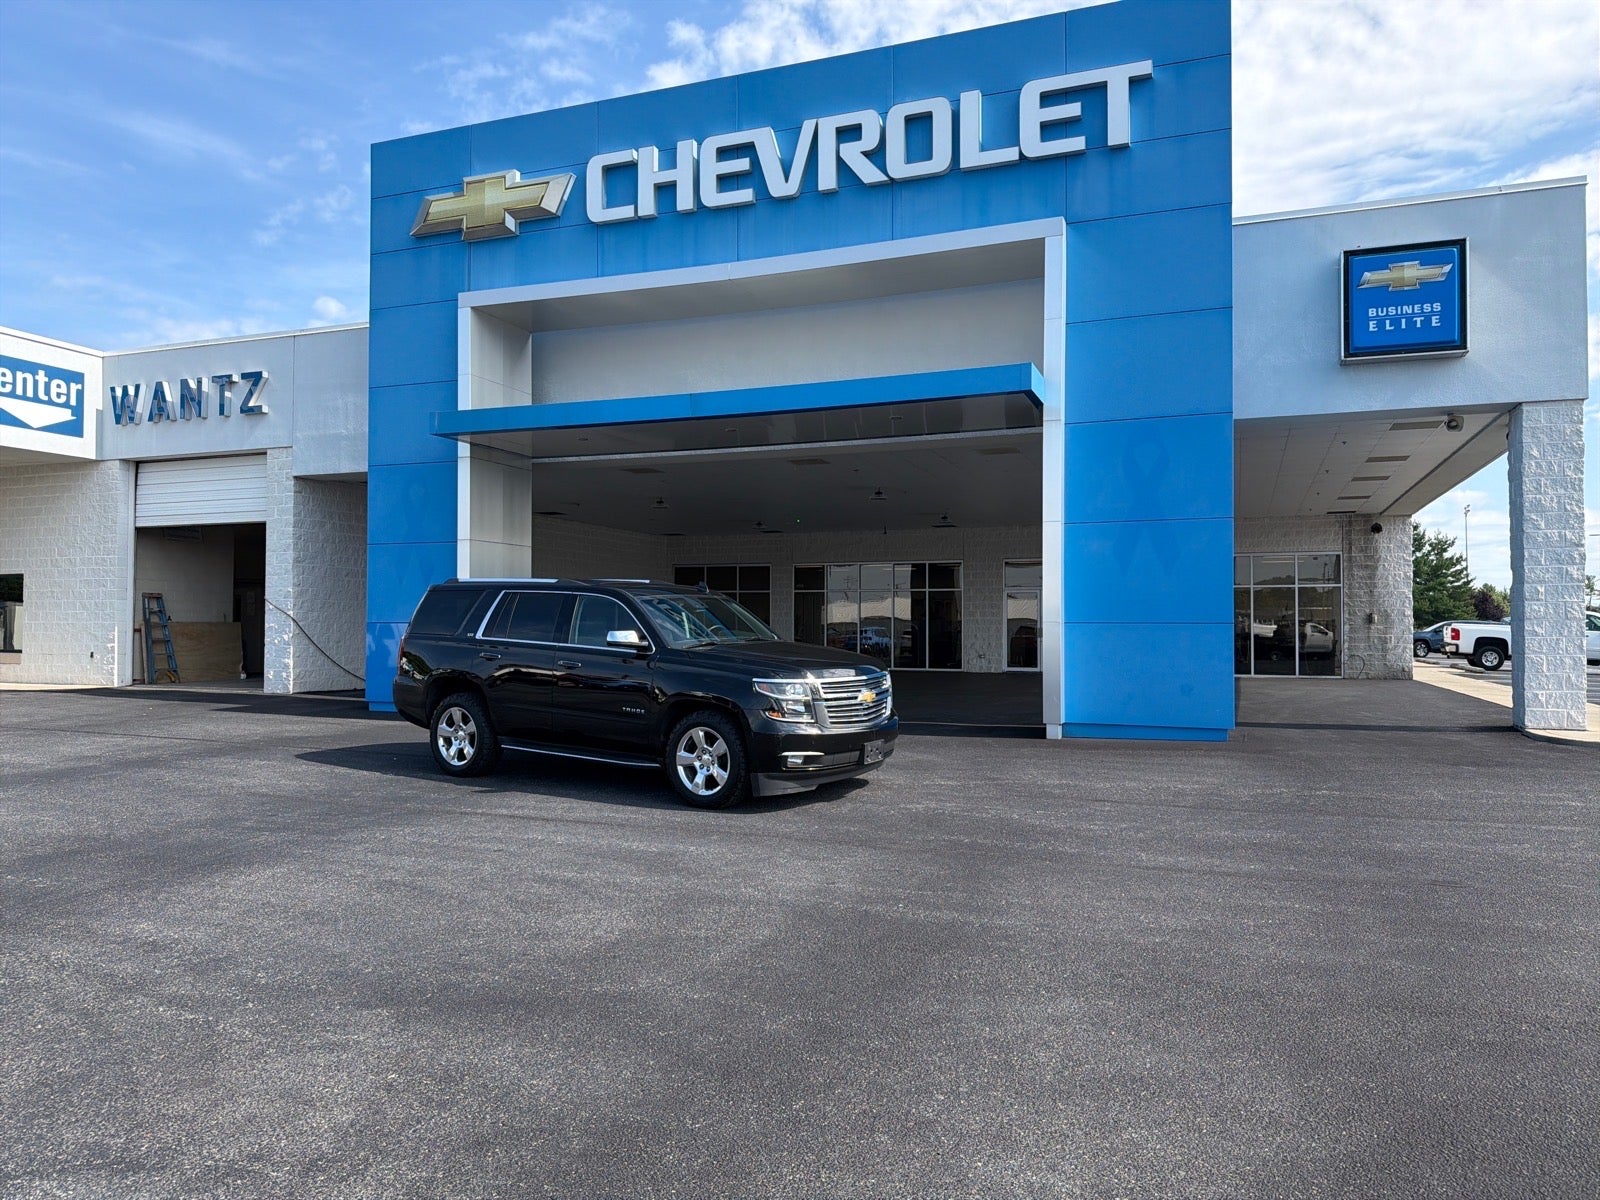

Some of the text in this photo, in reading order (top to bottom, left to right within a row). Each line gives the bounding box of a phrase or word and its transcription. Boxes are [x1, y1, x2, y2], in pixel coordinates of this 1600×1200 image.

[586, 60, 1153, 223] CHEVROLET
[1368, 302, 1442, 317] BUSINESS
[1368, 315, 1441, 332] ELITE
[110, 371, 269, 426] WANTZ
